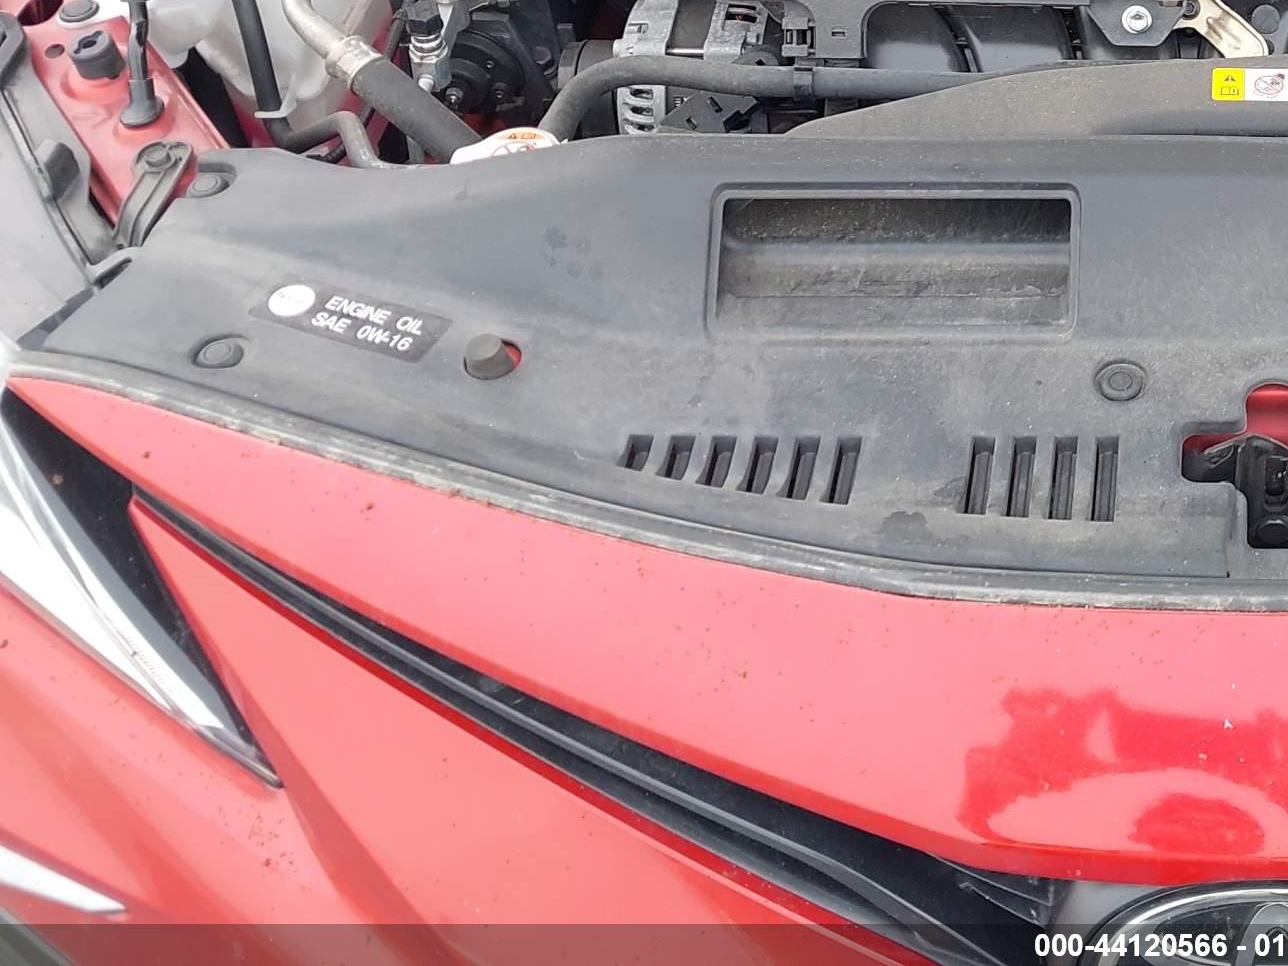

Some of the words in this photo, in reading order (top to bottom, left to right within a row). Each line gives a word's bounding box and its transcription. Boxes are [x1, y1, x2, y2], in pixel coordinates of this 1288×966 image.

[311, 312, 352, 334] SAE
[356, 325, 414, 352] 0W-16
[325, 295, 392, 326] ENGINE
[396, 316, 424, 336] OIL
